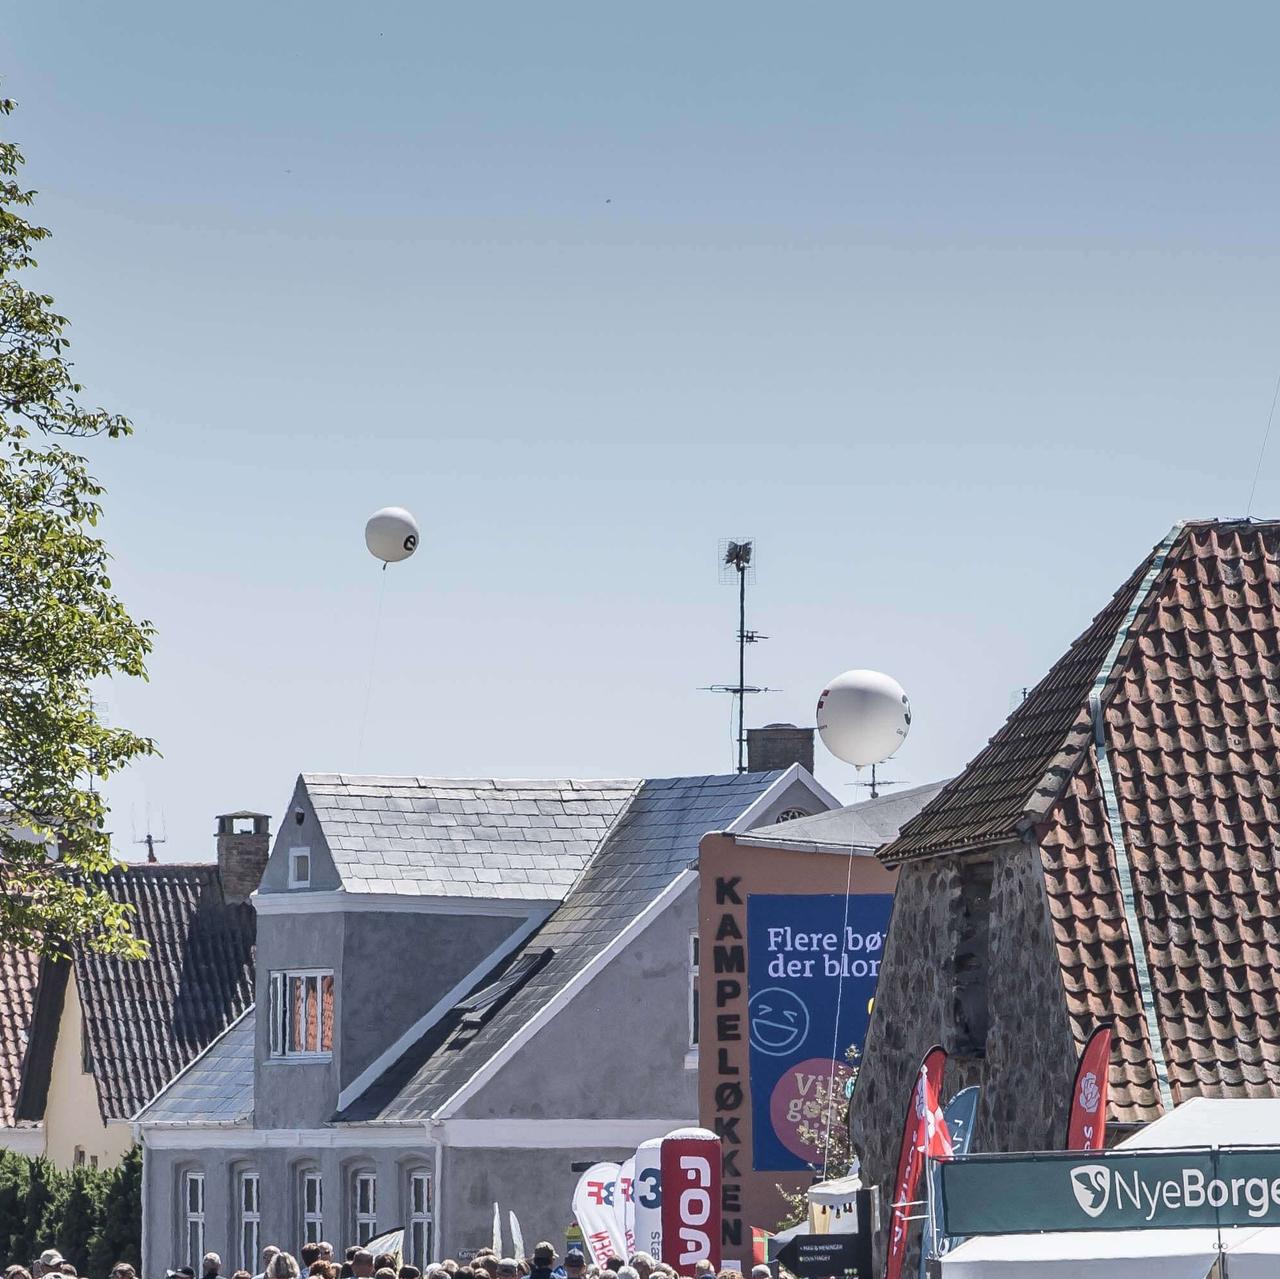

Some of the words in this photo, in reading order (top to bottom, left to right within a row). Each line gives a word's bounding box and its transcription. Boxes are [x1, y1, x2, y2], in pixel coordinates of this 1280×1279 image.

[767, 926, 839, 952] Flere
[845, 926, 888, 953] bø
[767, 953, 816, 978] der
[713, 876, 746, 1246] KAMPELØKKEN
[678, 1155, 712, 1266] FOA
